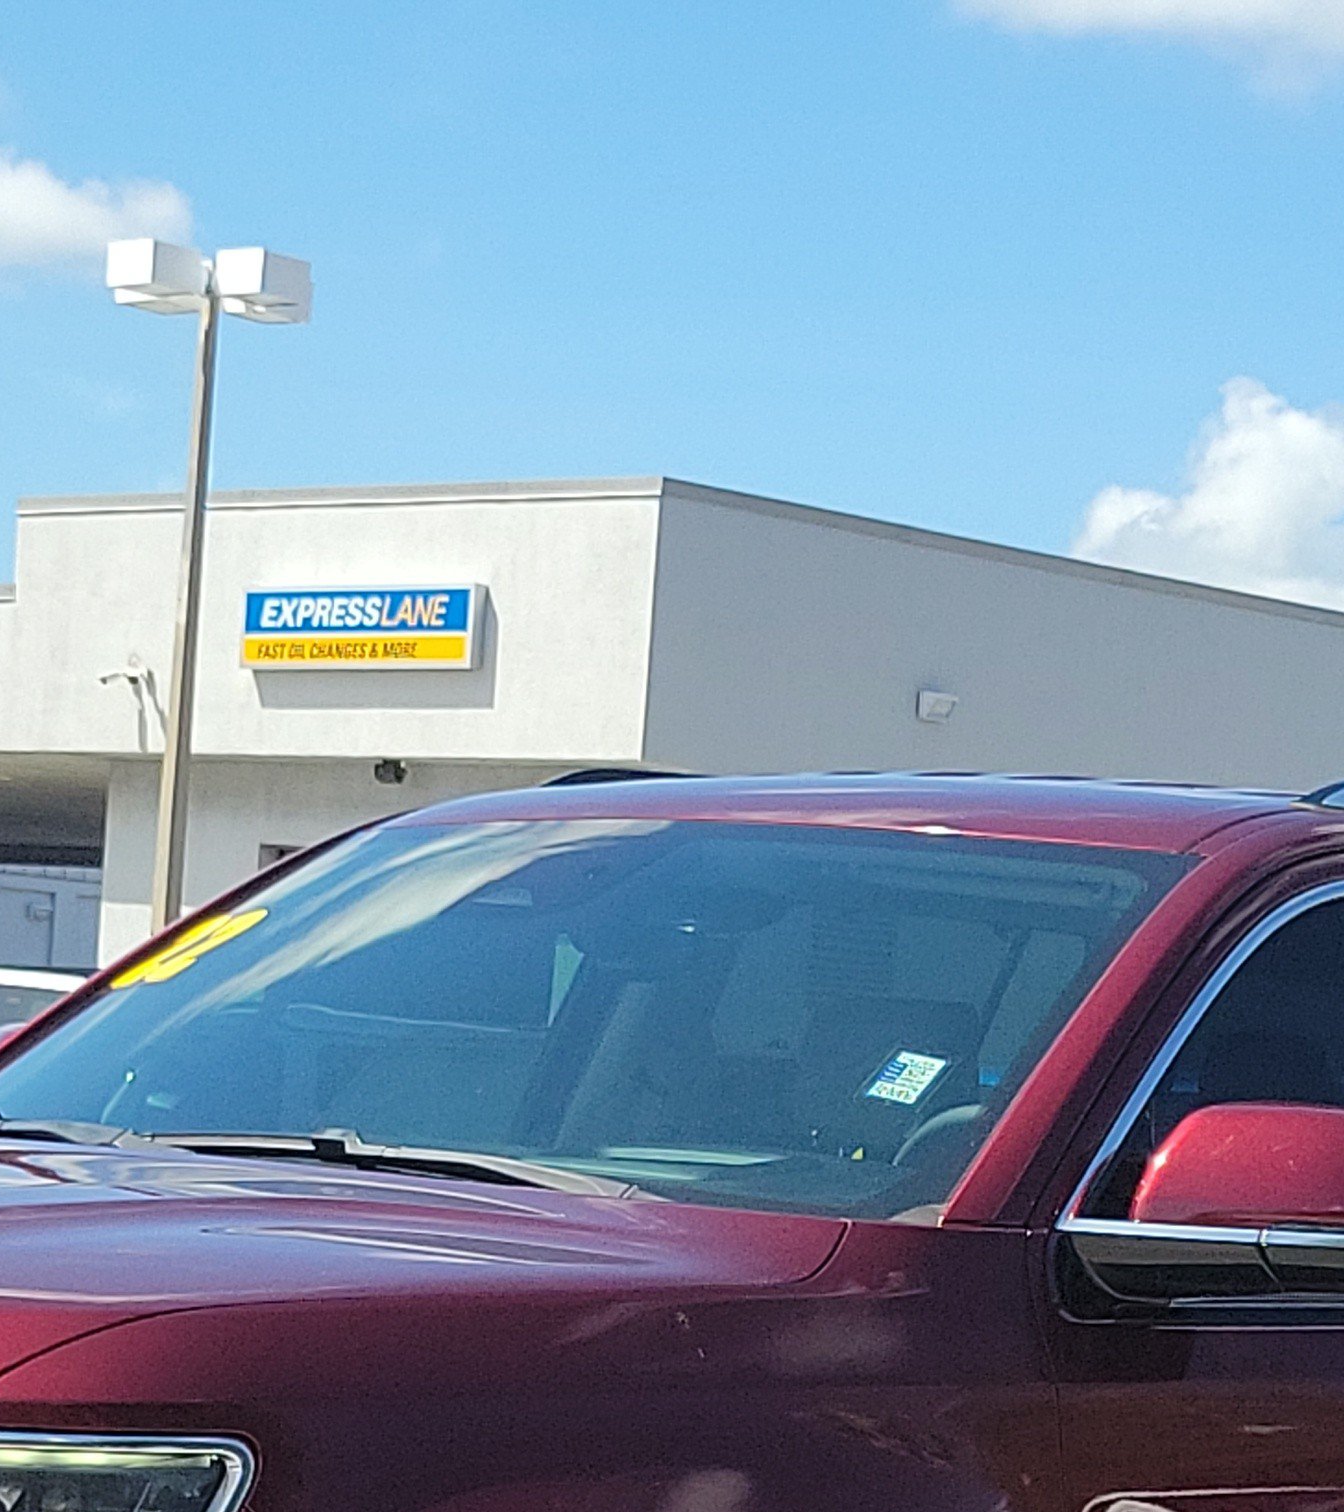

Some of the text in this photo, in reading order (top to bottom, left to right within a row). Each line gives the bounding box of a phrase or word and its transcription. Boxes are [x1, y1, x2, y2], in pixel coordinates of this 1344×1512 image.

[257, 641, 418, 660] FAST OIL CHANGES & MORE
